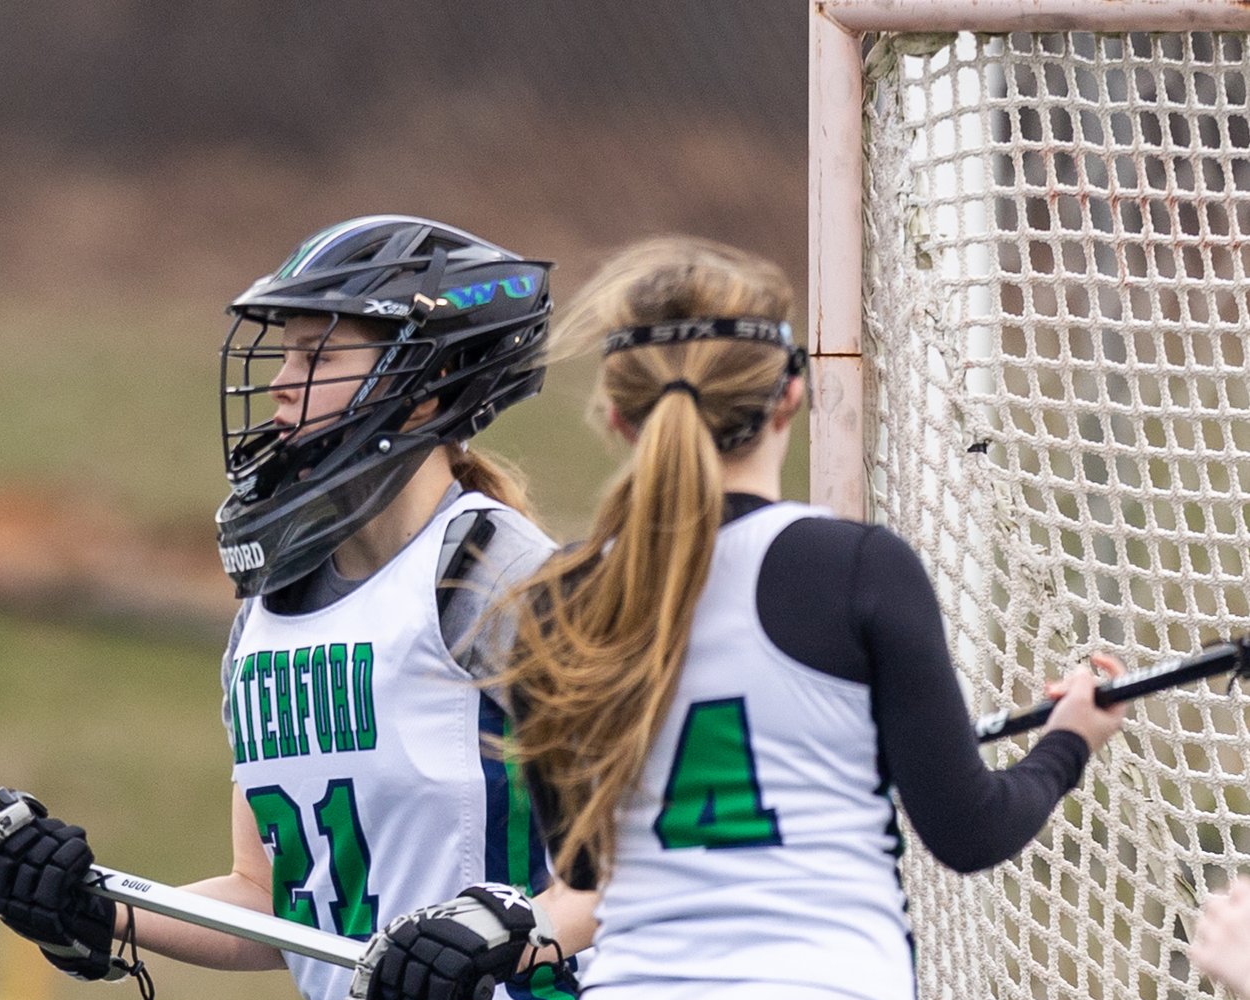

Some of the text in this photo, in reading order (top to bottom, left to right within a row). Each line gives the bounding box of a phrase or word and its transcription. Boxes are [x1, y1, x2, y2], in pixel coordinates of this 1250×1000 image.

[440, 275, 537, 310] WU
[605, 329, 636, 354] TX
[650, 321, 717, 345] STX
[653, 696, 784, 850] 4
[246, 777, 379, 941] 21
